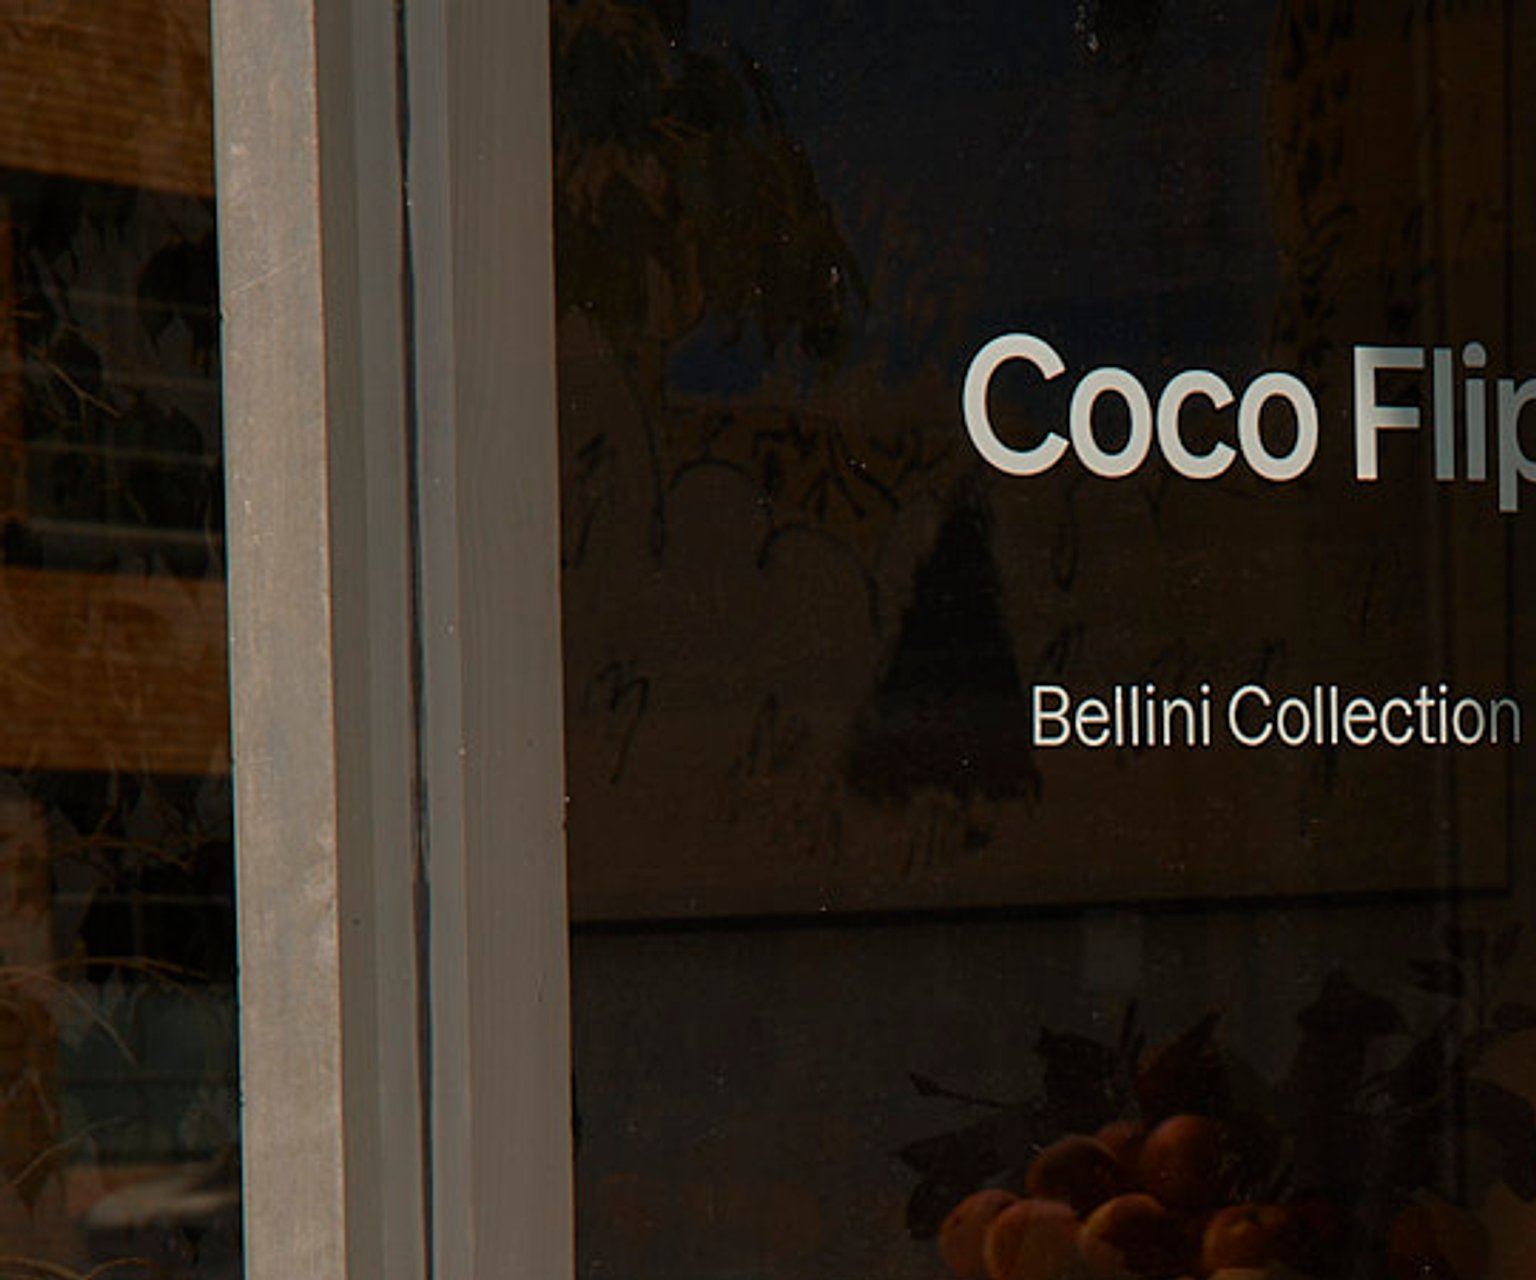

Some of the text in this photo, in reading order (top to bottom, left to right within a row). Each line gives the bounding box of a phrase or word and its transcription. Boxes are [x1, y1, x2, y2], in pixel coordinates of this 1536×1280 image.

[962, 332, 1319, 482] Coco
[1031, 684, 1522, 747] Bellini Collection
